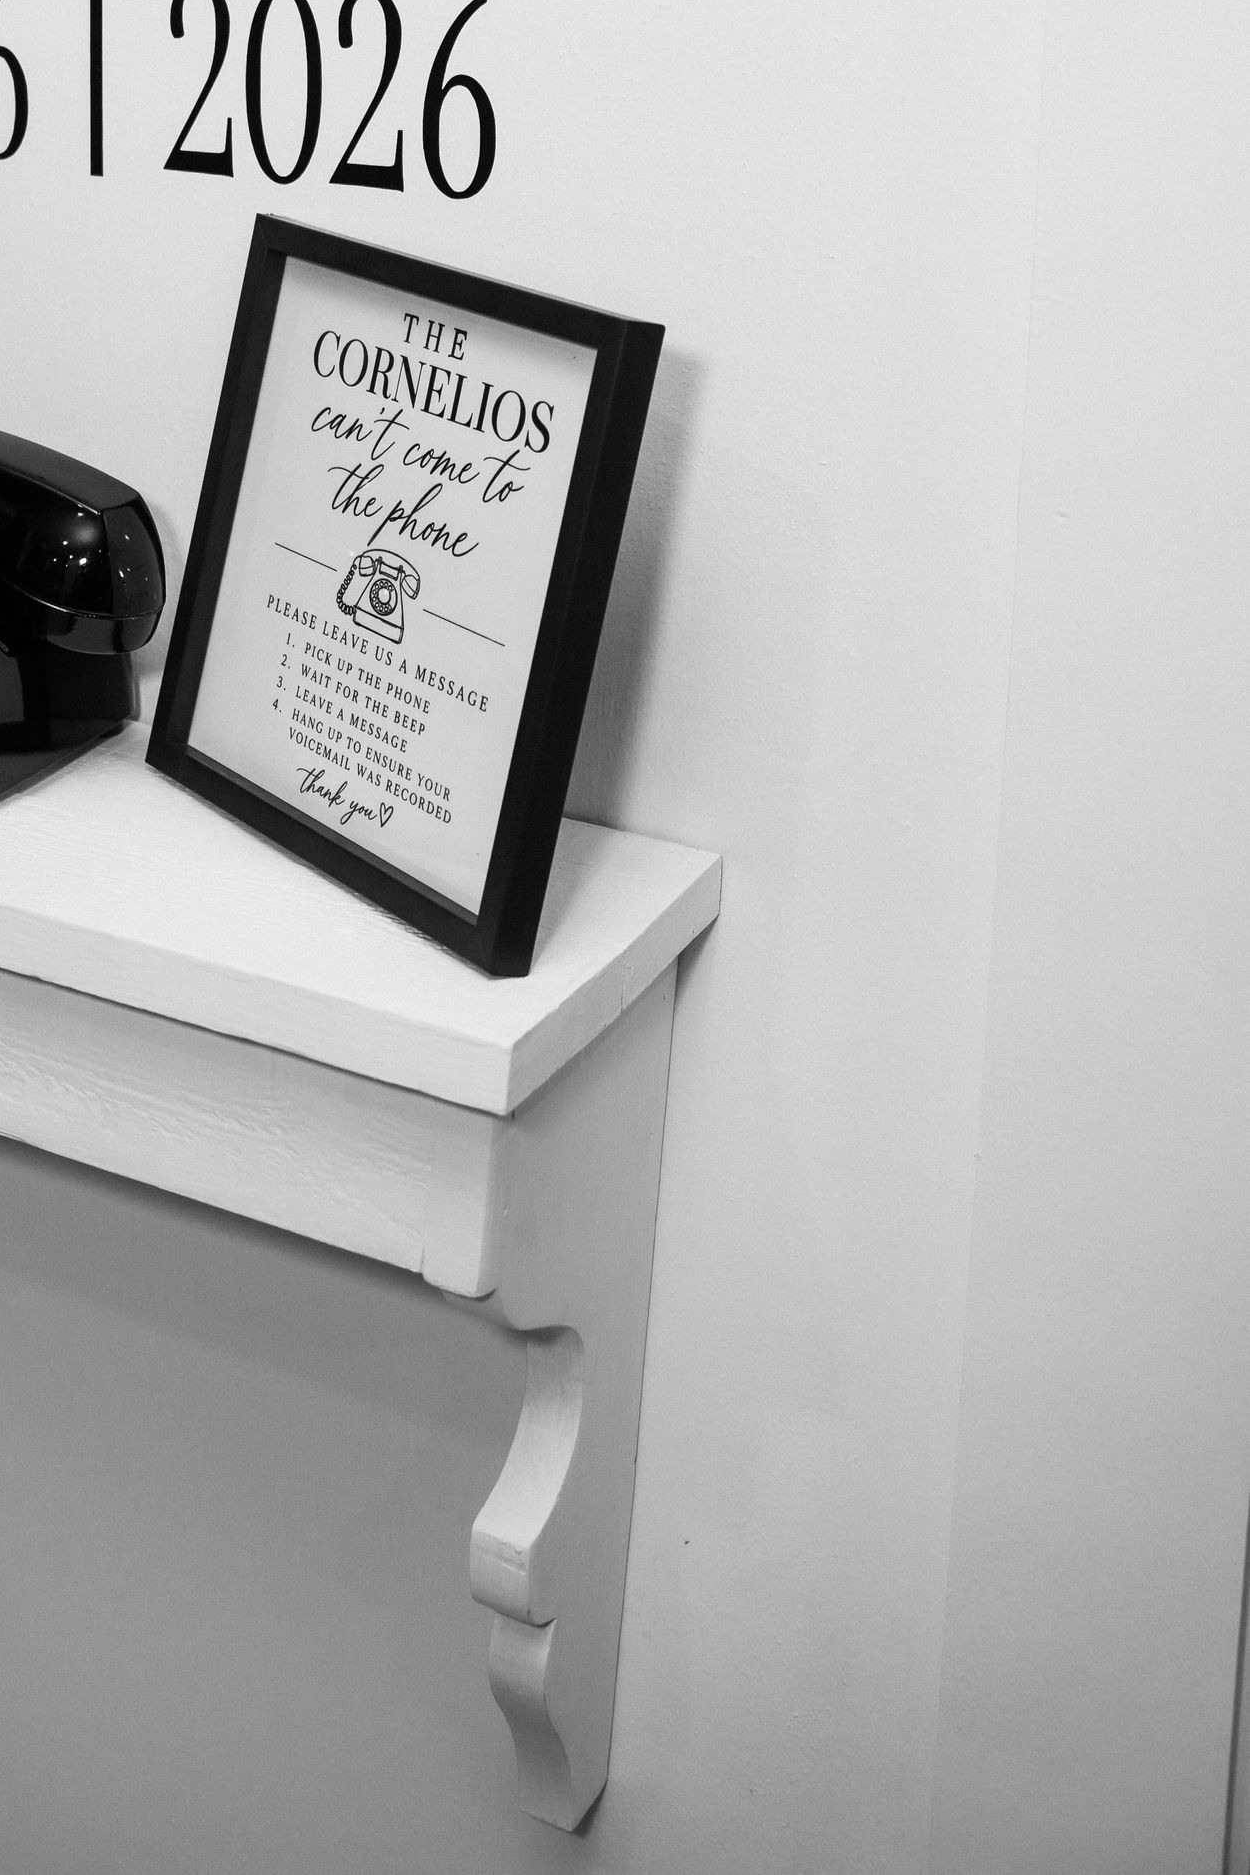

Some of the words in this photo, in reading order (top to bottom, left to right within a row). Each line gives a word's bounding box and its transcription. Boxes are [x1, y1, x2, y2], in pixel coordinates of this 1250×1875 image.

[403, 313, 468, 361] THE
[313, 330, 555, 453] CORNELIOS
[311, 406, 410, 461] can't
[403, 442, 480, 484] come
[482, 449, 531, 503] to
[328, 463, 384, 518] the
[367, 483, 479, 557] phone
[266, 594, 317, 630] PLEASE
[322, 620, 369, 655] LEAVE
[374, 645, 393, 666] US
[399, 659, 408, 674] A
[415, 665, 489, 713] MESSAGE
[281, 655, 290, 669] 2.
[301, 663, 331, 688] WAIT
[335, 681, 360, 703] FOR
[365, 696, 389, 718] THE
[393, 712, 426, 736] BEEP
[286, 633, 295, 648] 1.
[304, 642, 332, 666] PICK
[337, 658, 353, 675] UP
[358, 668, 382, 690] THE
[386, 682, 431, 714] PHONE
[272, 698, 282, 713] 4.
[292, 708, 324, 734] HANG
[327, 726, 342, 743] UP
[346, 736, 361, 754] TO
[365, 744, 412, 781] ENSURE
[417, 773, 451, 802] YOUR
[276, 676, 286, 691] 3.
[295, 685, 333, 715] LEAVE
[337, 709, 345, 721] A
[349, 714, 408, 753] MESSAGE
[288, 727, 351, 771] VOICEMAIL
[356, 763, 381, 787] WAS
[385, 780, 452, 824] RECORDED
[296, 766, 346, 808] thank
[340, 800, 377, 825] you
